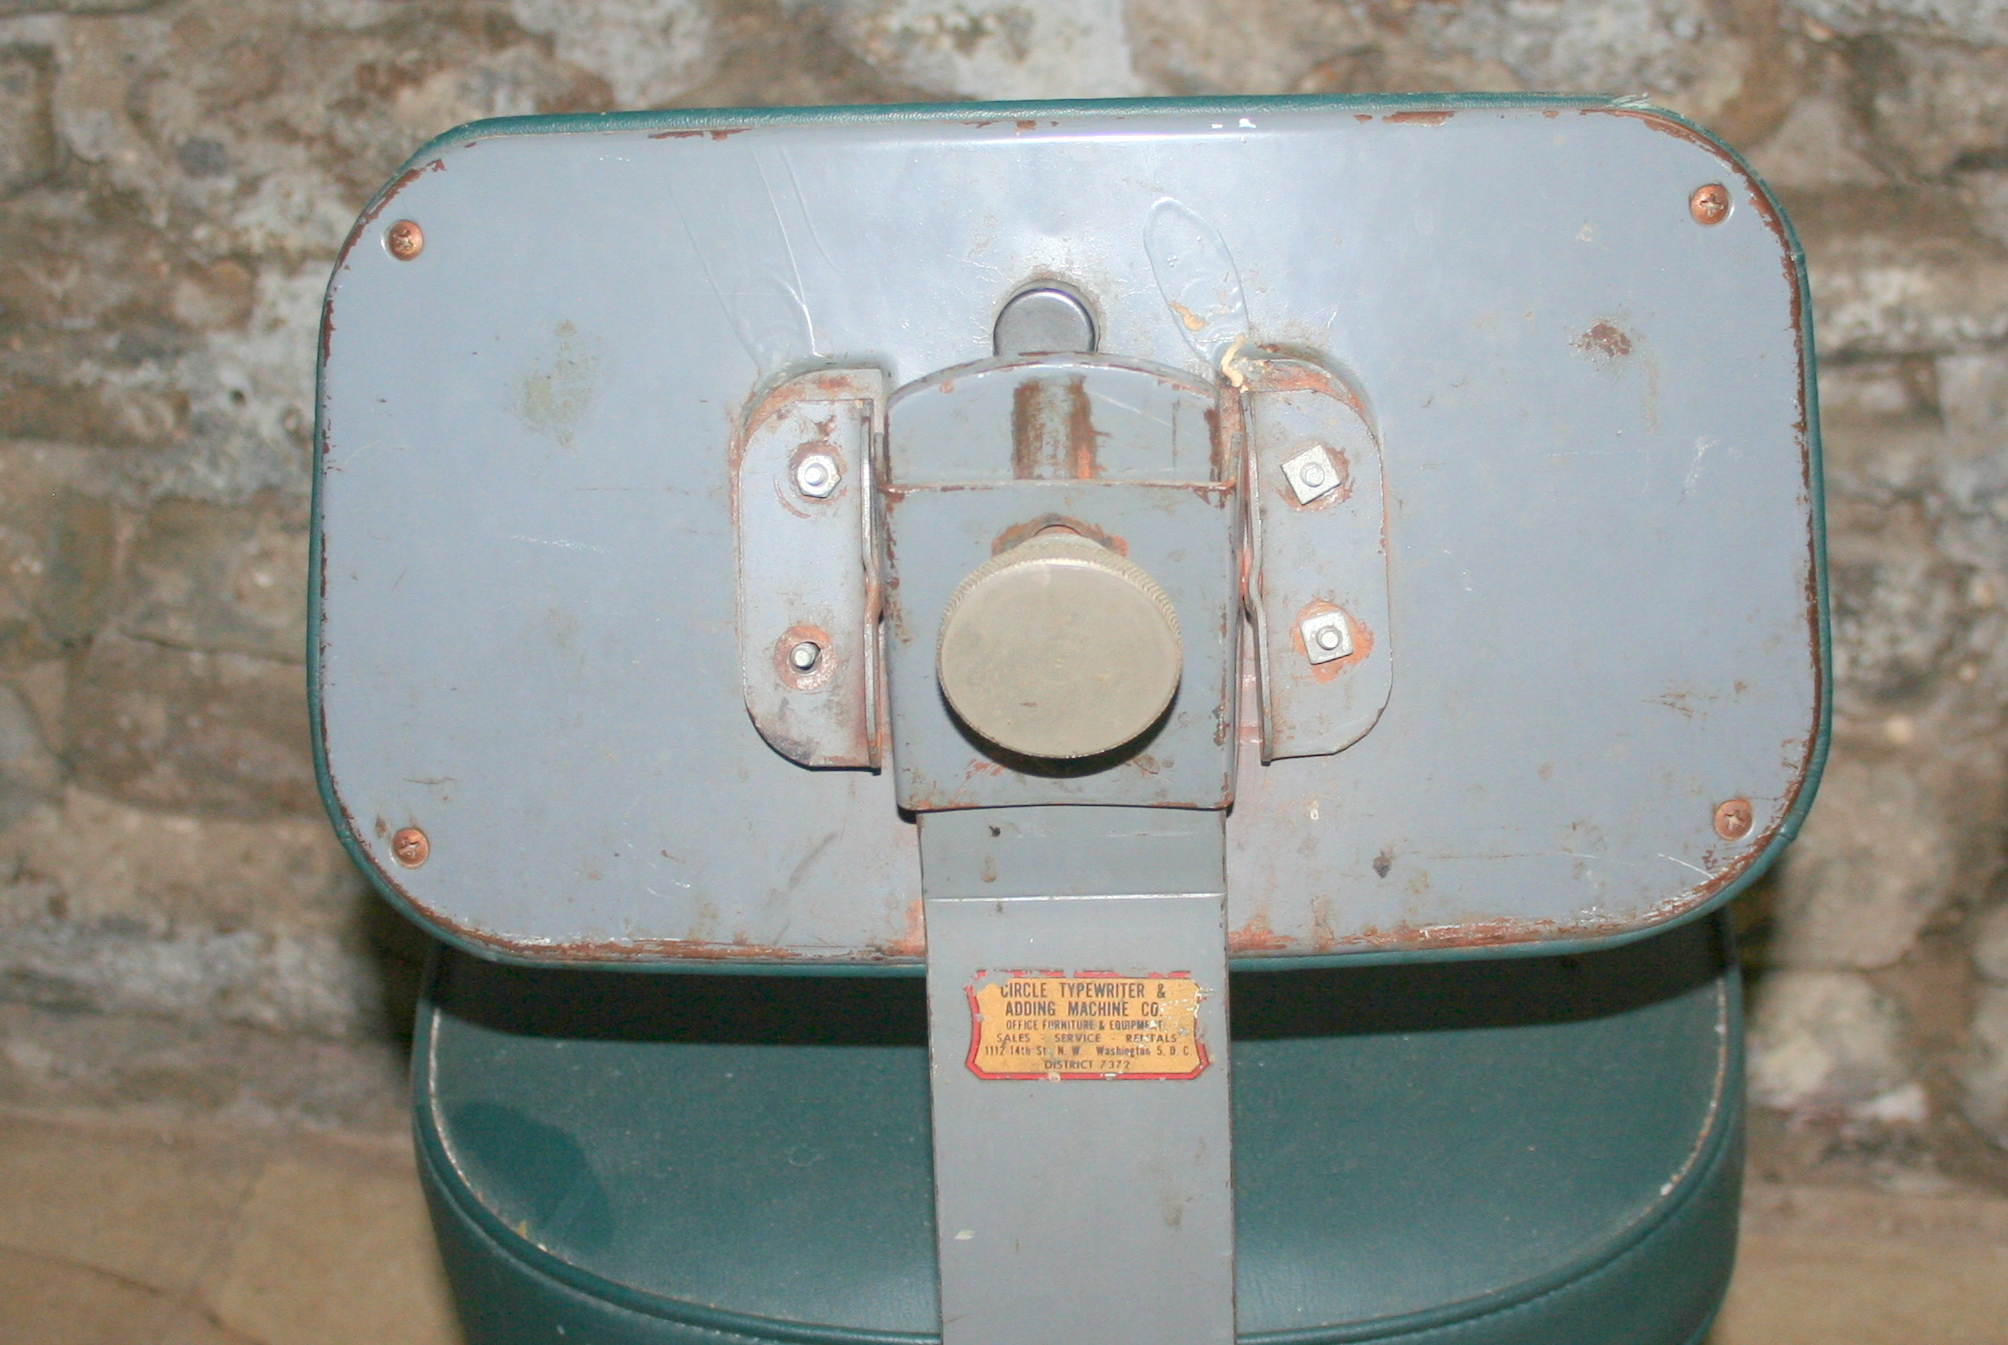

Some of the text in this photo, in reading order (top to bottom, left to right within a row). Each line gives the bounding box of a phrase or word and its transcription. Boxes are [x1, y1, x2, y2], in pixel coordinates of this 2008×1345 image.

[1000, 982, 1166, 999] CIRCLE TYPEWRITER &
[1005, 1001, 1163, 1017] ADDING MACHINE CO.
[1006, 1019, 1163, 1031] OFFICE FURNITURE & EQUIPMET
[996, 1033, 1031, 1043] SALES
[1054, 1033, 1101, 1043] SERVICE
[985, 1046, 1004, 1056] 1112
[1010, 1045, 1031, 1055] 14th
[1095, 1046, 1151, 1057] Washington
[1044, 1060, 1093, 1069] DISTRICT
